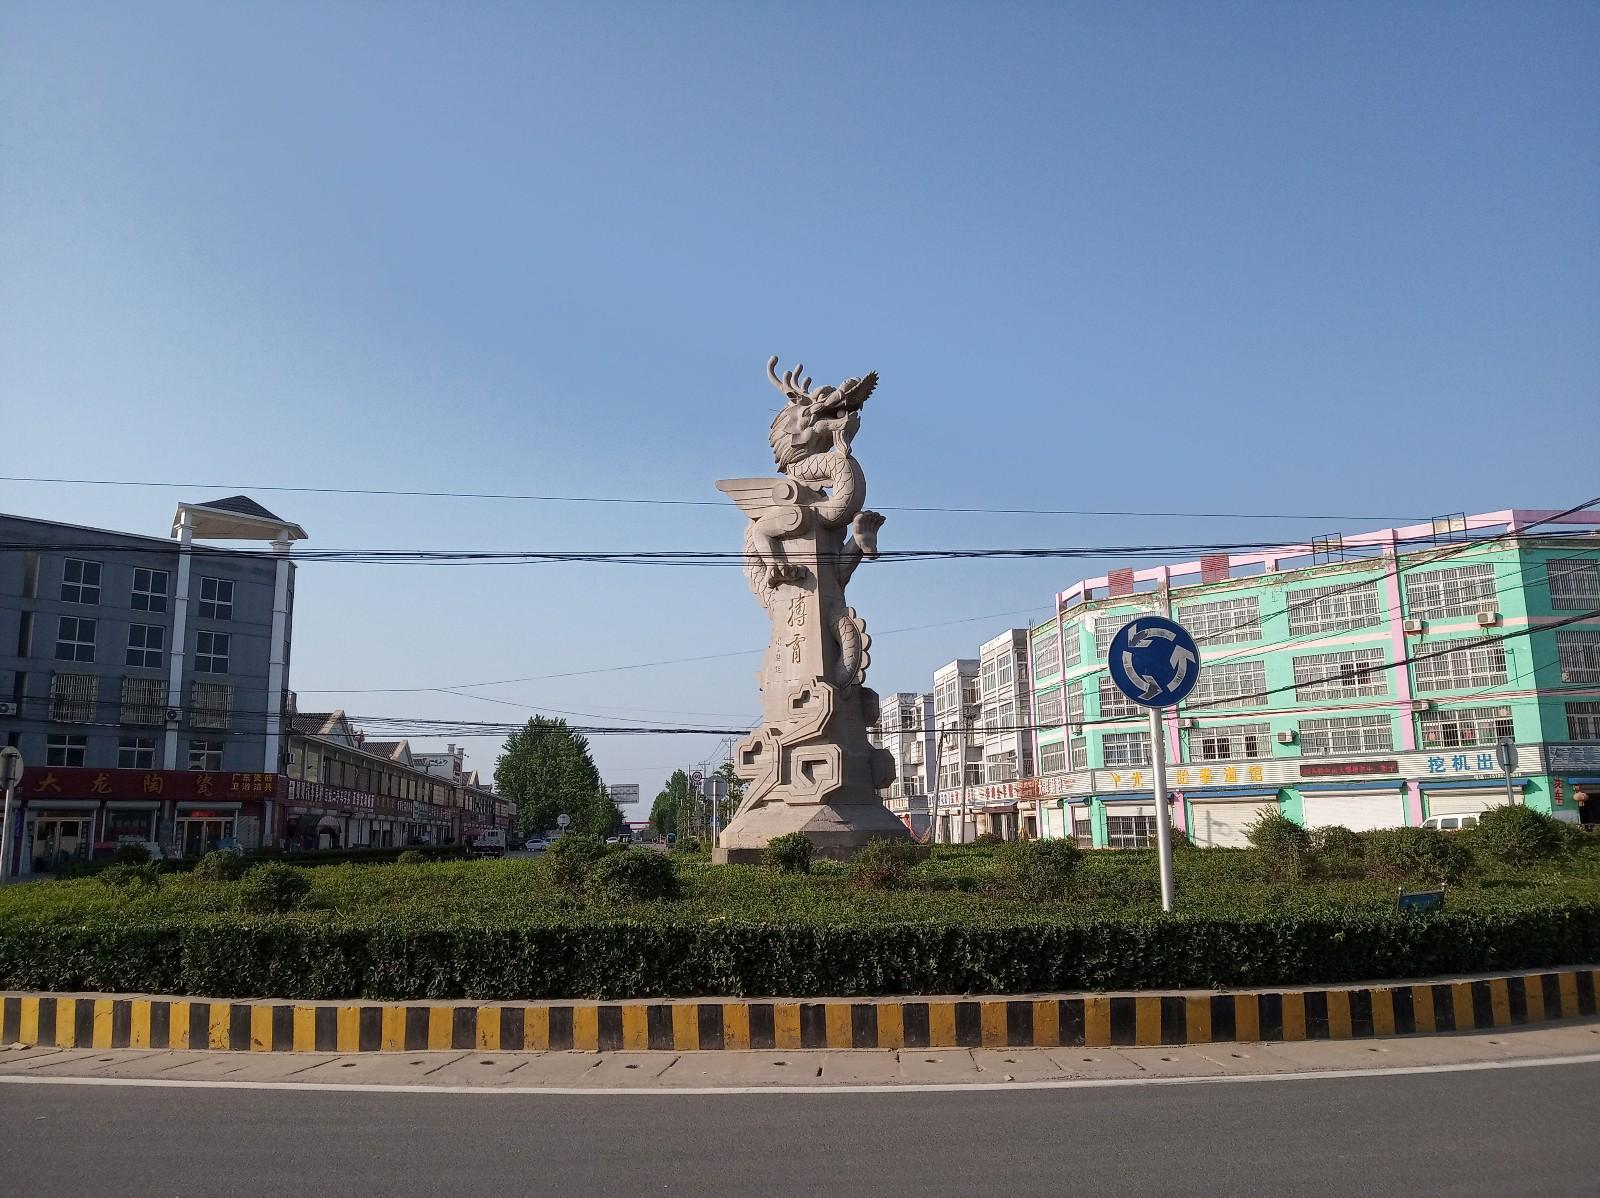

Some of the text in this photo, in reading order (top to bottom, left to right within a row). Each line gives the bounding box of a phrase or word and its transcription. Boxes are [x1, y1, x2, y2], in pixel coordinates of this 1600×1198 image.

[35, 773, 215, 796] 大龙陶瓷
[231, 782, 273, 792] 卫浴洁具
